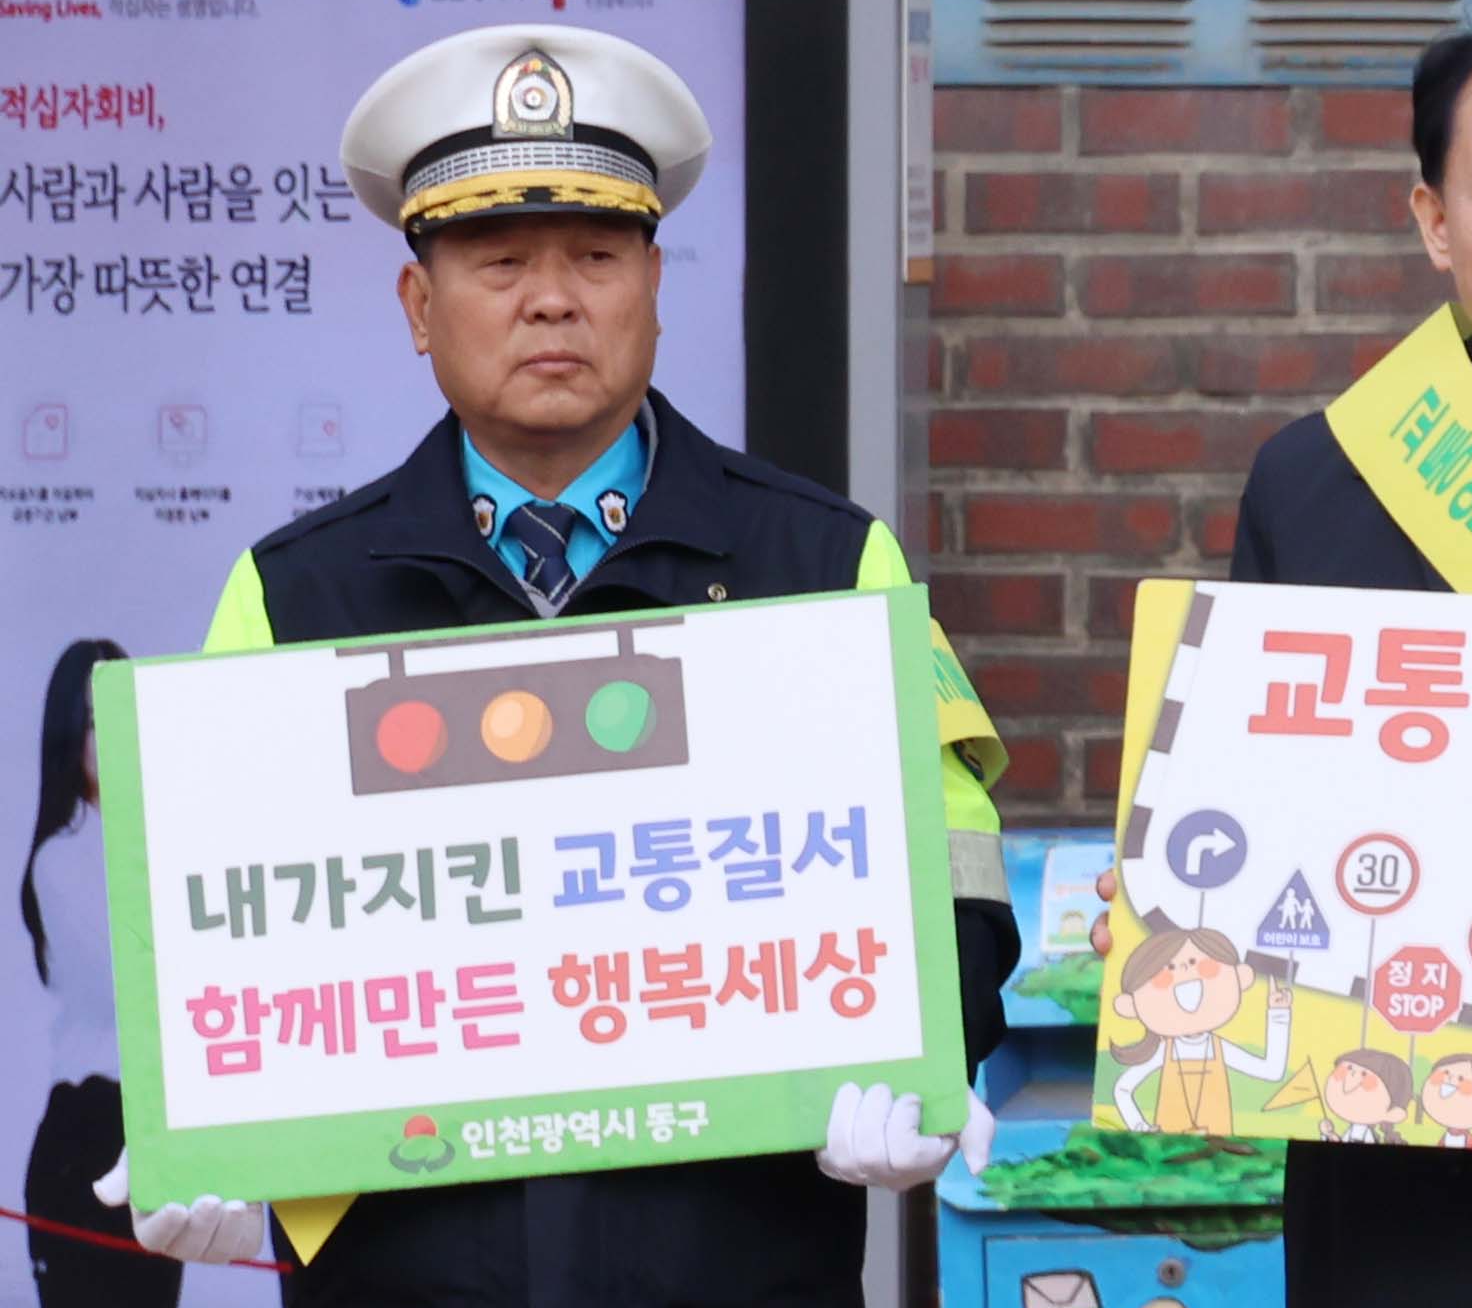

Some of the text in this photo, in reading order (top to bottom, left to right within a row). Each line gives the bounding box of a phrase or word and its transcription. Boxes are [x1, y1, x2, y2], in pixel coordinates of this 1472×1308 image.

[0, 82, 166, 132] 적십자회비,
[0, 162, 356, 224] 사람과 사람을 잇는
[0, 253, 313, 315] 가장 따뜻한 연결
[184, 804, 871, 939] 내가지킨 교통질서
[1356, 853, 1400, 888] 30
[185, 927, 888, 1077] 함께만든 행복세상
[1387, 992, 1446, 1019] STOP
[459, 1098, 710, 1158] 인천광역시 동구
